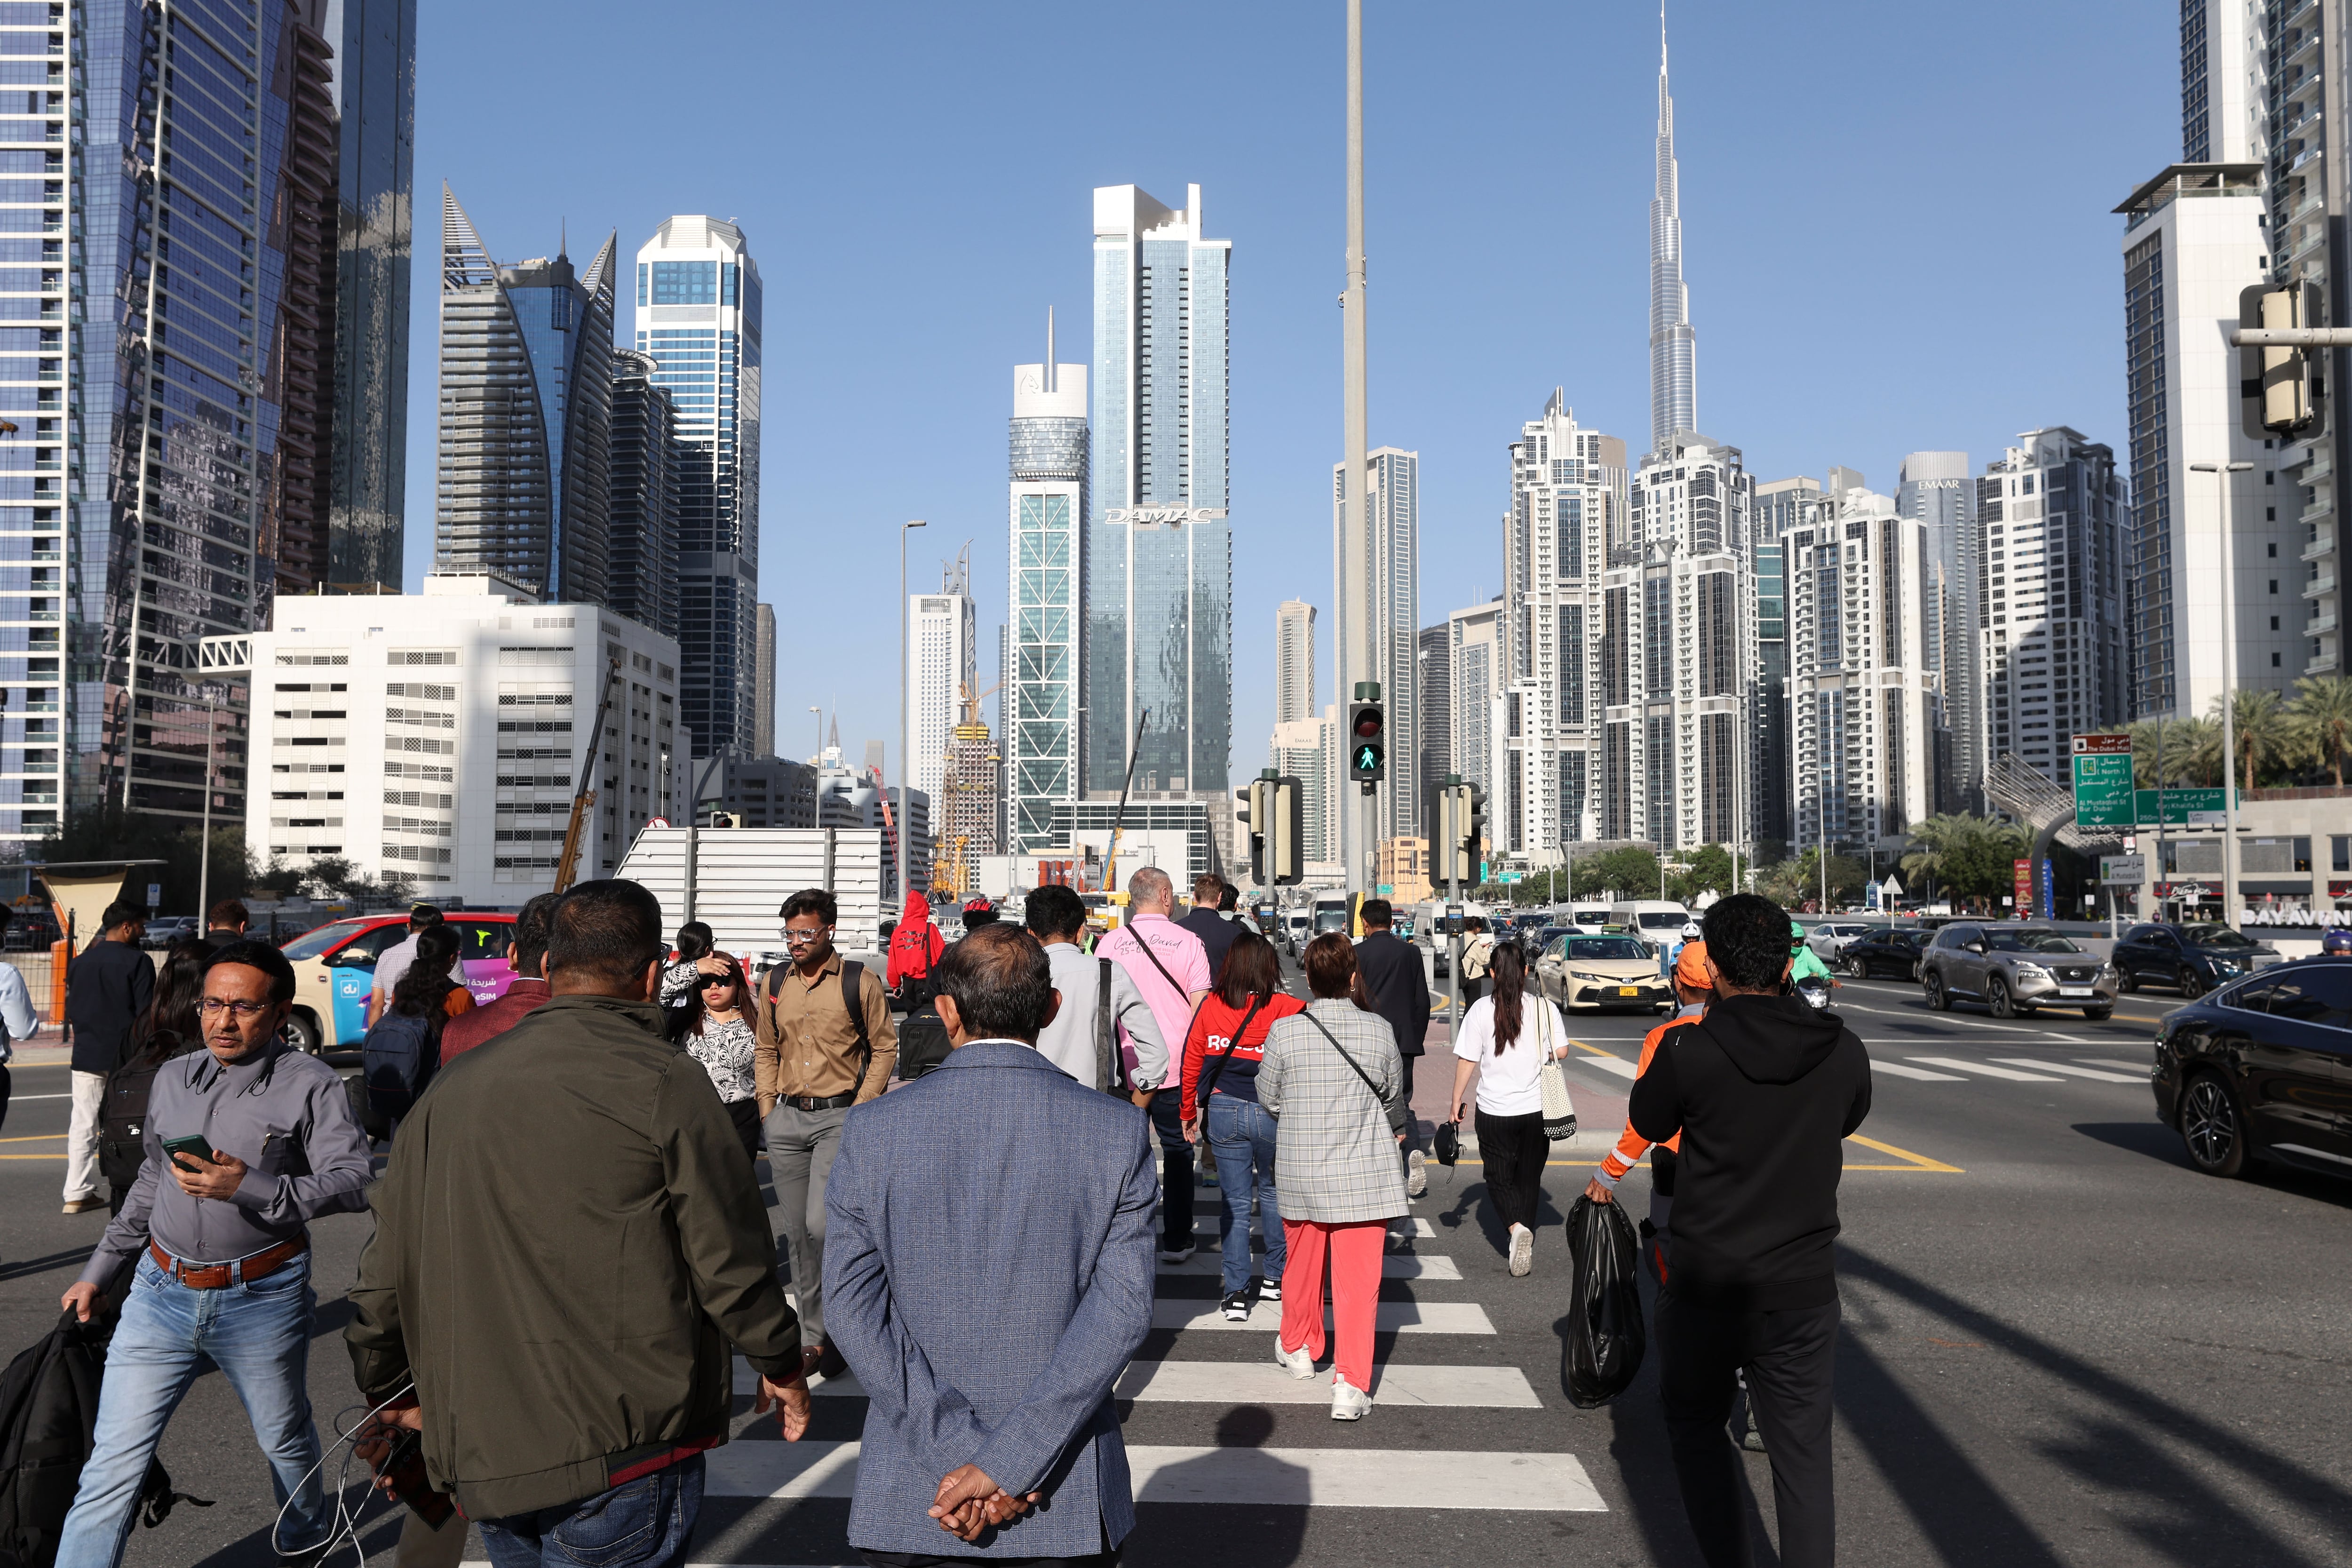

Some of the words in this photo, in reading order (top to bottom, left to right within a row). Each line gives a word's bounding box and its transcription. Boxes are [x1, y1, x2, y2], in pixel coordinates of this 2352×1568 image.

[1919, 480, 1959, 490] EMAAR
[1106, 509, 1213, 522] DAMAC
[2241, 909, 2283, 925] BAY
[1149, 934, 1183, 950] David
[471, 977, 496, 987] شريحة
[343, 983, 358, 995] du
